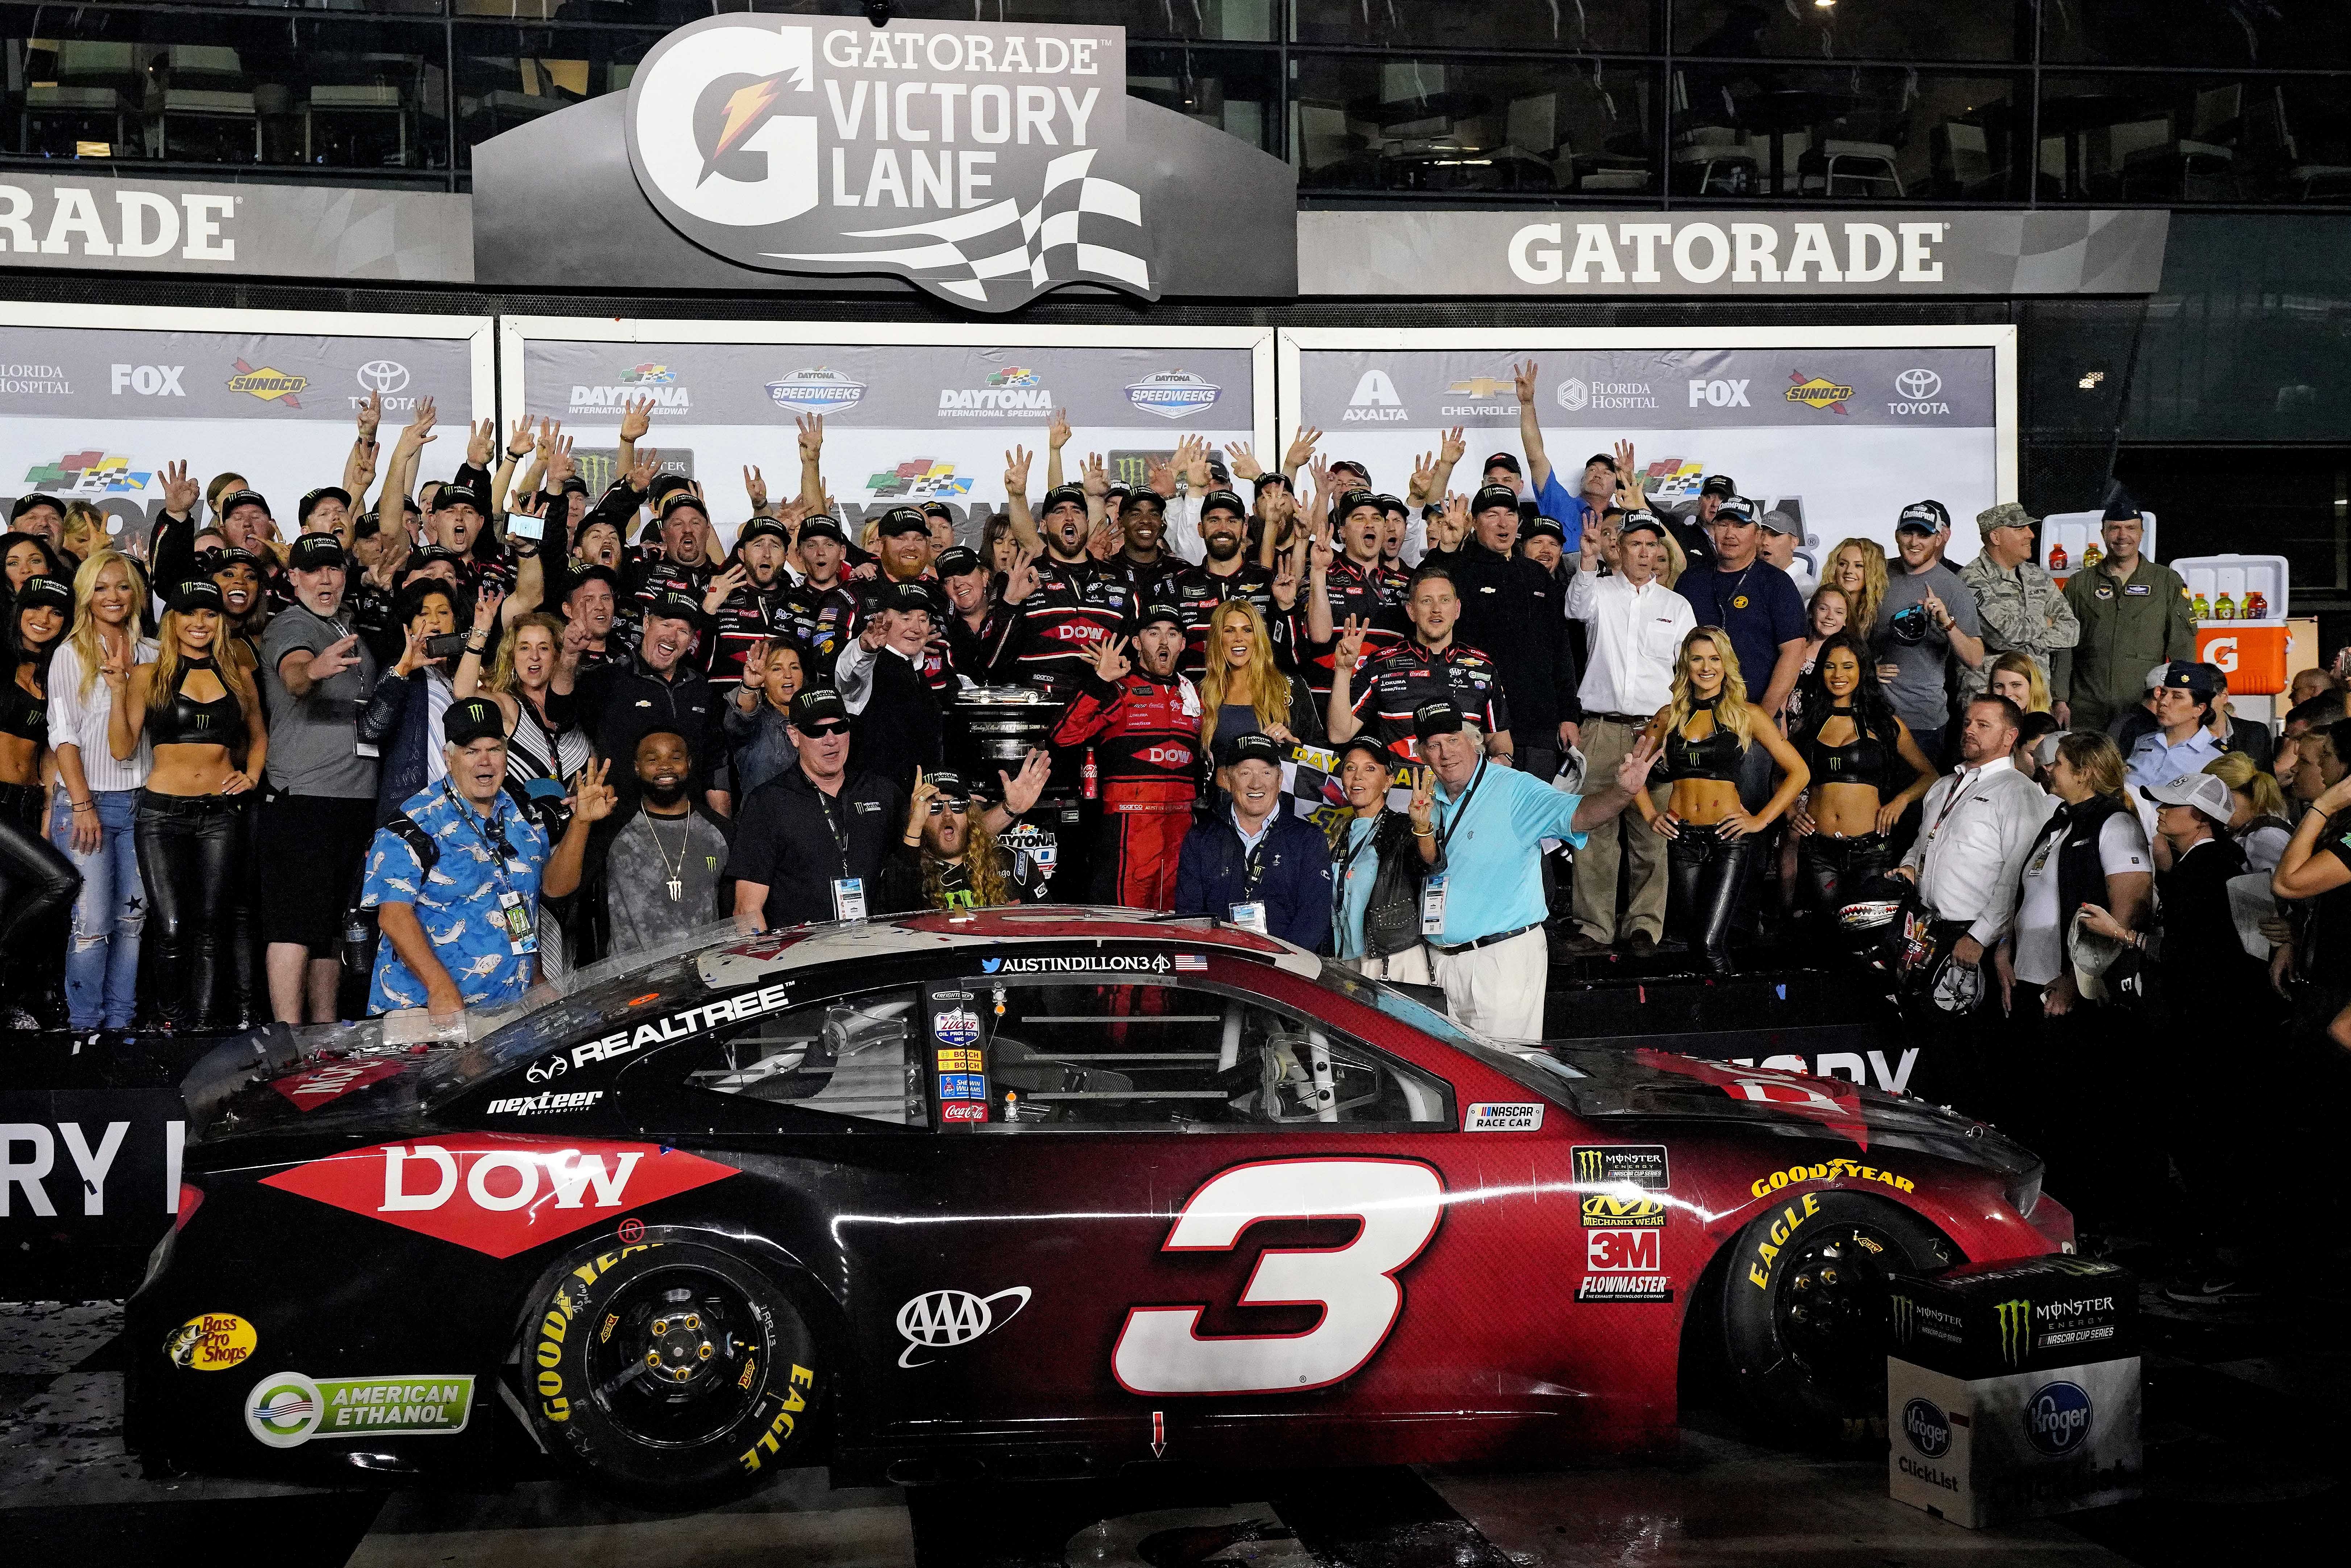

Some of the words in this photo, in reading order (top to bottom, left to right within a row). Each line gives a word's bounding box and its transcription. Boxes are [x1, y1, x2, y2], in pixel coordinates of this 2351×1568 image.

[824, 80, 1100, 145] VICTORY
[832, 148, 997, 209] LANE
[111, 363, 186, 396] FOX
[230, 375, 304, 392] SUNOCO
[1591, 381, 1651, 394] FLORIDA
[570, 385, 689, 407] DAYTONA
[772, 387, 860, 399] SPEEDWEEKS
[941, 389, 1052, 409] DAYTONA
[1131, 390, 1215, 402] SPEEDWEEKS
[1591, 395, 1659, 408] HOSPITAL
[1689, 379, 1751, 407] FOX
[1789, 388, 1850, 399] SUNOCO
[348, 396, 419, 411] TOOTA
[1887, 402, 1950, 415] TOYOTA
[1342, 408, 1409, 421] AXALTA
[1629, 514, 1660, 526] CHAMPION
[1903, 510, 1935, 523] CHAMPION
[43, 580, 68, 591] MONSTER
[193, 582, 217, 591] MONSTER
[678, 594, 698, 607] MONSTER
[1199, 597, 1218, 608] Coca-Cola
[1058, 625, 1104, 640] DOW
[2203, 637, 2238, 673] G
[1426, 703, 1449, 711] MONSTER
[1149, 748, 1191, 764] DOW
[996, 833, 1054, 847] AYTONA
[1001, 956, 1150, 972] AUSTINDILLON3
[573, 983, 790, 1068] REALTREE
[940, 1021, 976, 1030] LUCAS
[486, 1091, 604, 1115] nexteer
[531, 1106, 590, 1115] AUTOMOTIVE
[1491, 1106, 1533, 1116] NASCAR
[945, 1105, 985, 1119] Coca-Cola
[1606, 1153, 1662, 1164] MONSTER
[0, 1122, 131, 1216] RY
[377, 1145, 645, 1212] DOW
[1751, 1159, 1915, 1198] GOODYEAR
[1583, 1215, 1634, 1226] MECHANIX
[1635, 1215, 1665, 1226] WEAR
[1591, 1232, 1657, 1268] 3M
[1749, 1193, 1820, 1290] EAGLE
[1112, 1157, 1445, 1394] 3
[1579, 1276, 1666, 1298] FLOWMASTER
[907, 1292, 984, 1341] AAA
[1916, 1306, 1963, 1328] MONSTER
[2036, 1297, 2114, 1320] MONSTER
[202, 1316, 237, 1332] Bass
[602, 1317, 617, 1340] AERO
[2049, 1317, 2103, 1330] ENERGY
[203, 1332, 230, 1347] Pro
[537, 1243, 665, 1422] GOODYEA
[1938, 1330, 1947, 1339] CUP
[2047, 1331, 2075, 1345] NASCAR
[2074, 1330, 2090, 1343] CUP
[2090, 1327, 2114, 1339] SERIES
[203, 1345, 247, 1364] Shops
[740, 1362, 753, 1386] AERO
[329, 1385, 459, 1406] AMERICAN
[335, 1403, 449, 1426] ETHANOL
[739, 1363, 814, 1475] EAGLE
[2032, 1395, 2087, 1446] Kroger
[1907, 1406, 1948, 1450] Kroger
[1898, 1456, 1958, 1492] ClickList
